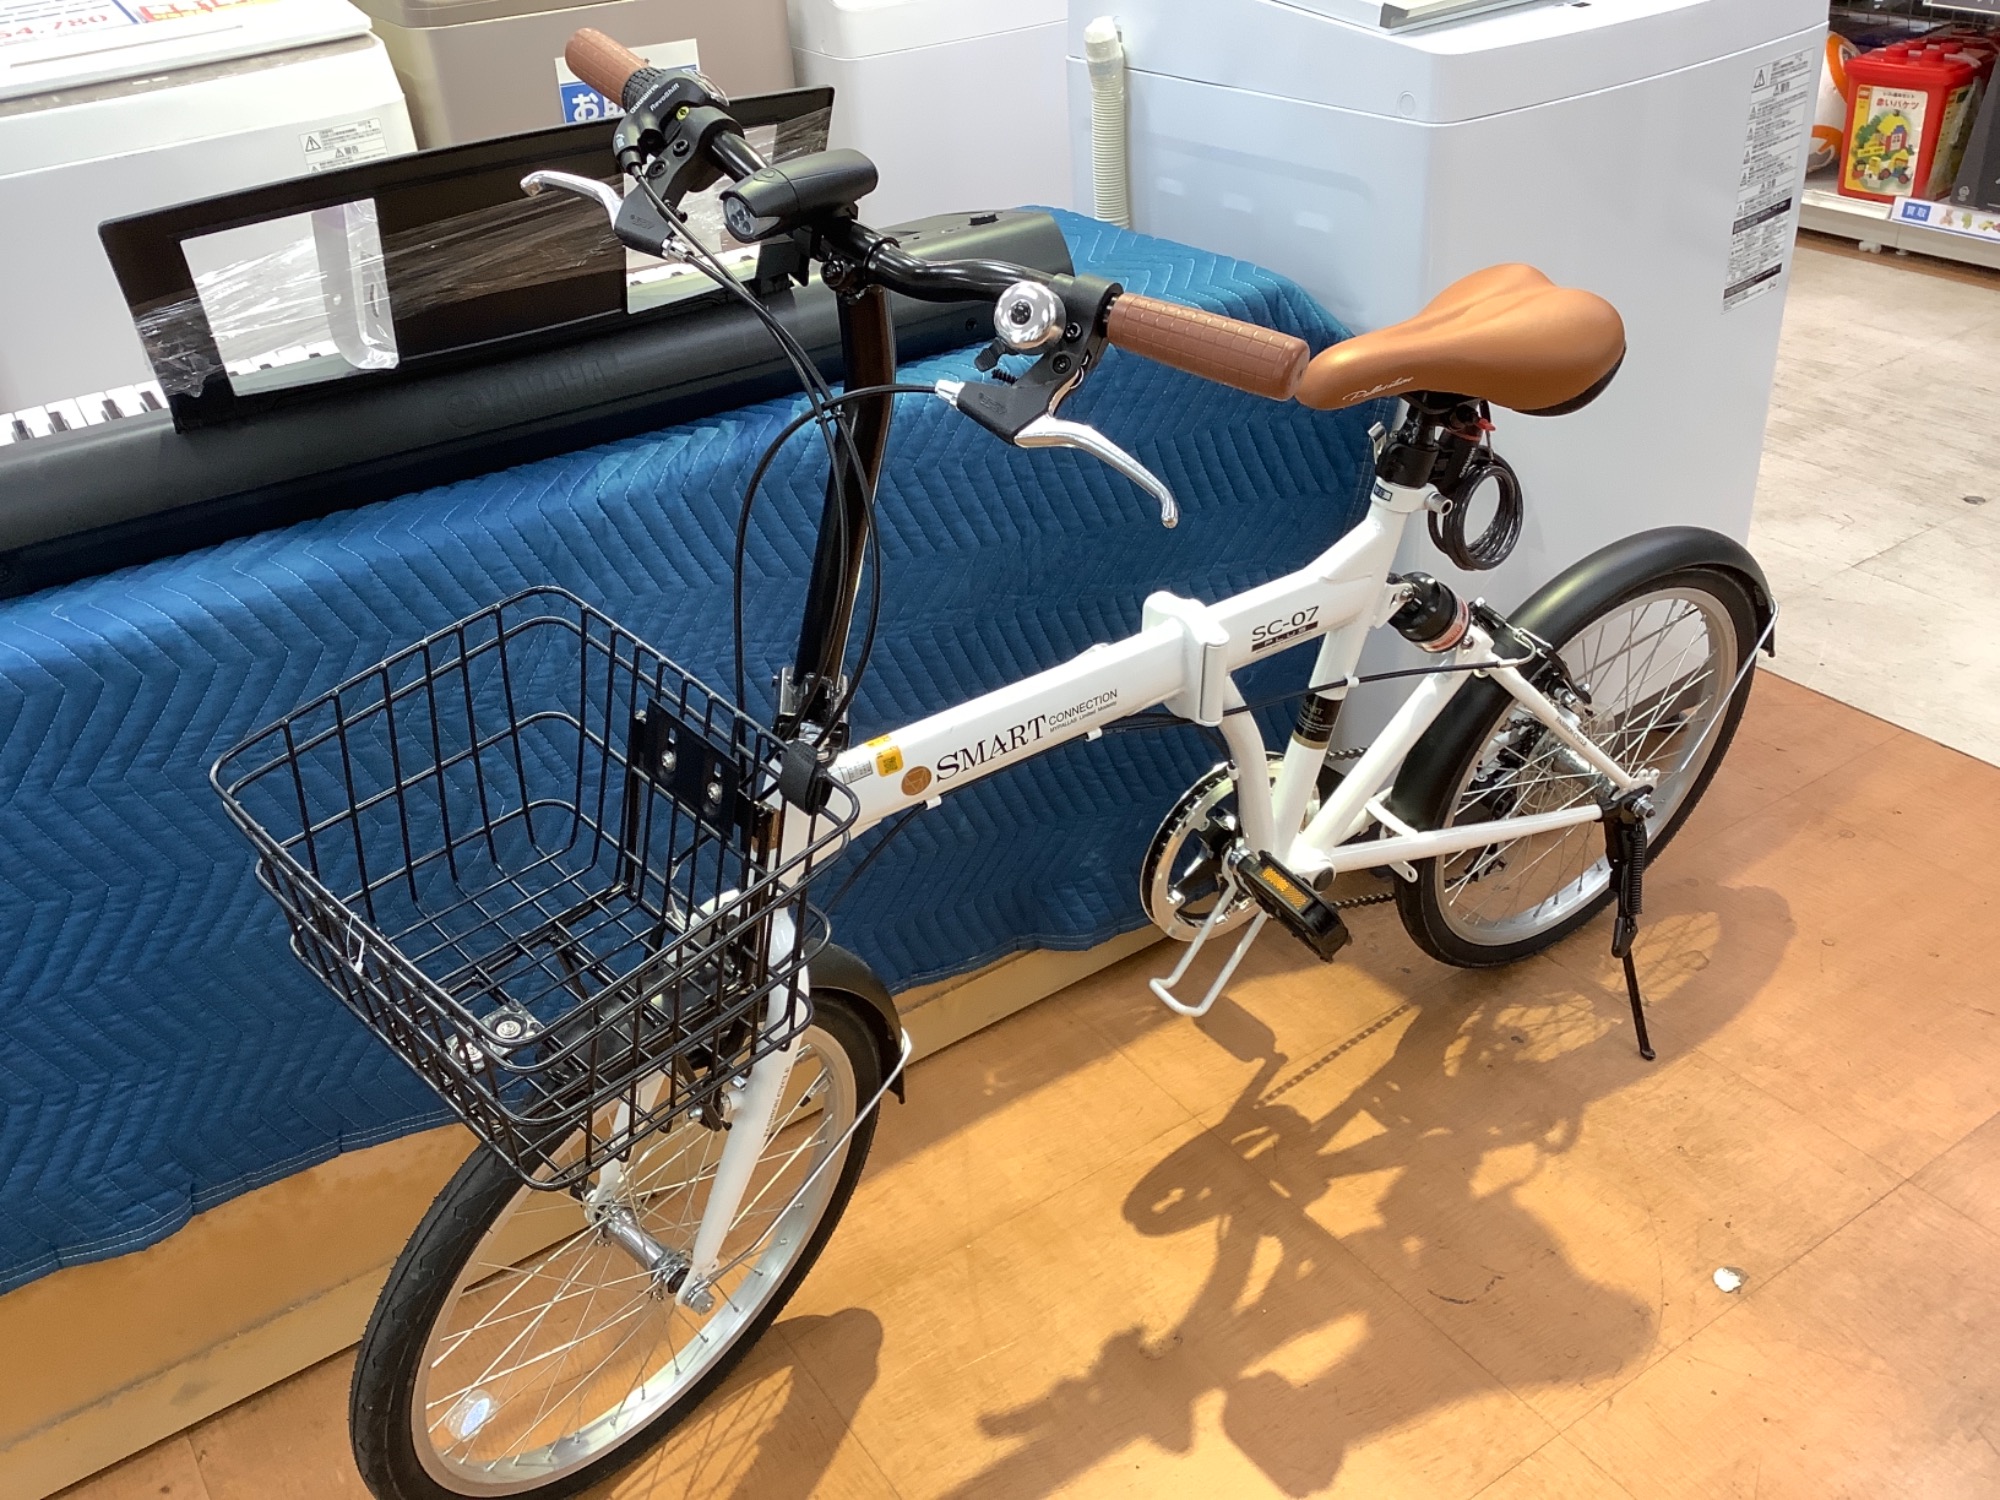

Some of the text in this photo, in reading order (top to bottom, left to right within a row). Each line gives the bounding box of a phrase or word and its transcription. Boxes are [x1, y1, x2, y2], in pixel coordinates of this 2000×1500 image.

[1252, 605, 1320, 642] SC-07
[936, 714, 1047, 783] SMART
[1048, 688, 1118, 727] CONNECTION
